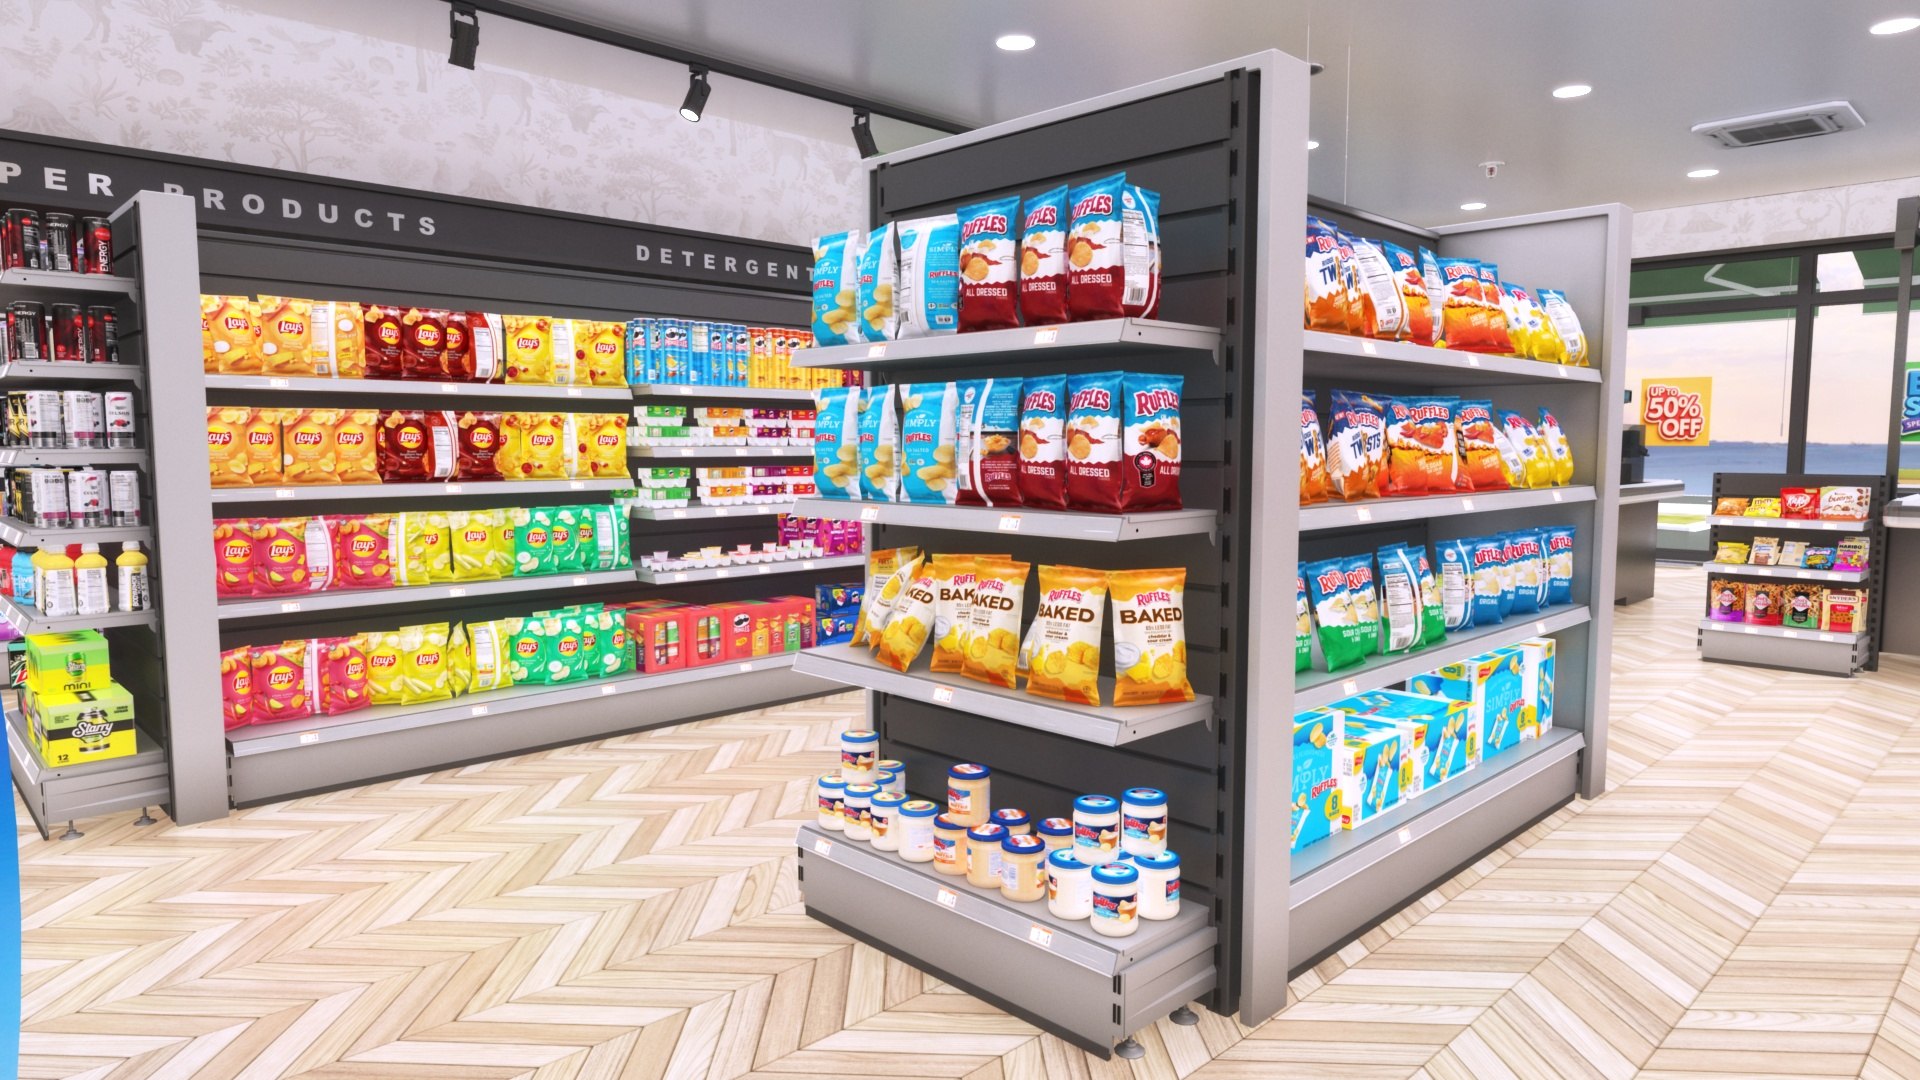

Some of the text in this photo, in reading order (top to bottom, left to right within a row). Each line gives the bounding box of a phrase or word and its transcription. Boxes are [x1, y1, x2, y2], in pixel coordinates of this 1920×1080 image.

[0, 162, 114, 197] PER
[98, 240, 109, 272] ENERGY
[1071, 273, 1113, 284] ALL DRESSED
[966, 287, 1008, 297] ALL DRESSED
[1028, 282, 1057, 292] DRESSED
[1650, 387, 1678, 397] UP TO
[1135, 389, 1179, 416] RUFFLES
[1647, 395, 1699, 418] 50%
[1410, 405, 1449, 422] RUFFLES
[1662, 418, 1702, 436] OFF
[208, 431, 231, 444] ay's
[1027, 466, 1055, 477] DRESSED
[1070, 466, 1110, 478] ALL DRESSED
[1159, 467, 1170, 475] ALL
[552, 530, 569, 540] ay's
[224, 544, 251, 558] Lay's
[269, 544, 296, 557] Lay's
[352, 538, 377, 551] Lay's
[940, 588, 975, 601] BAK
[1048, 590, 1082, 602] RUFFLES
[1136, 591, 1170, 606] RUFFLES
[973, 593, 1014, 611] AKED
[1038, 603, 1095, 623] BAKED
[1119, 607, 1182, 624] BAKED
[371, 655, 396, 666] Lay's
[417, 652, 439, 665] Lay's
[268, 670, 295, 685] Lay's
[63, 682, 91, 691] mini
[72, 720, 114, 737] Starry
[1311, 778, 1338, 799] RUFFLES
[1331, 795, 1338, 811] 8
